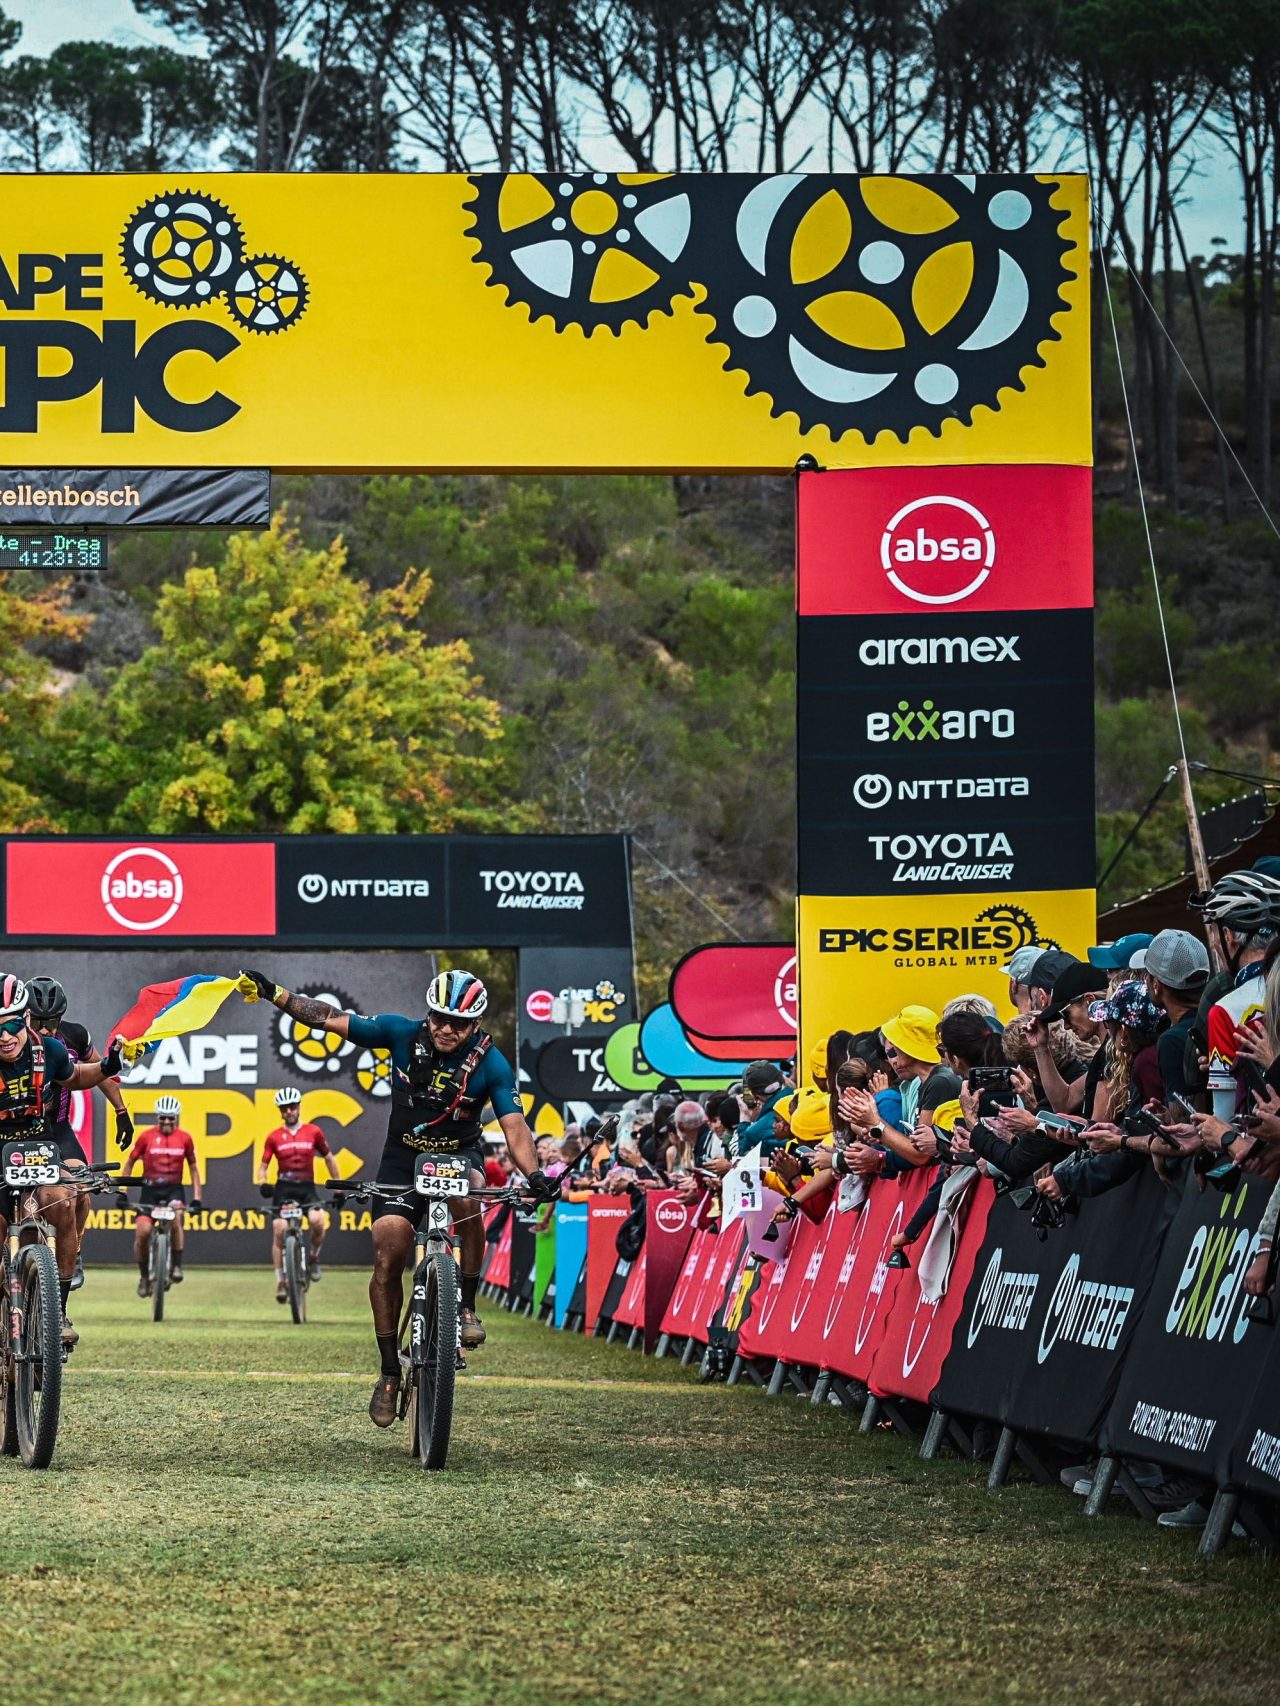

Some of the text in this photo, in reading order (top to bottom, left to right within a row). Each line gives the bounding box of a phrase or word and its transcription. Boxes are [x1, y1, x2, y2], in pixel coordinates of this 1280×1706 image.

[54, 535, 101, 551] Drea
[895, 528, 982, 562] absa
[19, 551, 100, 566] 4:23:38
[859, 635, 1021, 666] aramex
[867, 700, 1015, 741] exxaro
[868, 832, 1014, 860] TOYOTA
[111, 871, 173, 899] absa
[479, 871, 584, 893] TOYOTA
[894, 955, 998, 968] GLOBAL MTB
[24, 1156, 49, 1166] EPIC
[10, 1168, 56, 1180] 543-2
[422, 1179, 463, 1193] 543-1
[659, 1208, 684, 1220] absa
